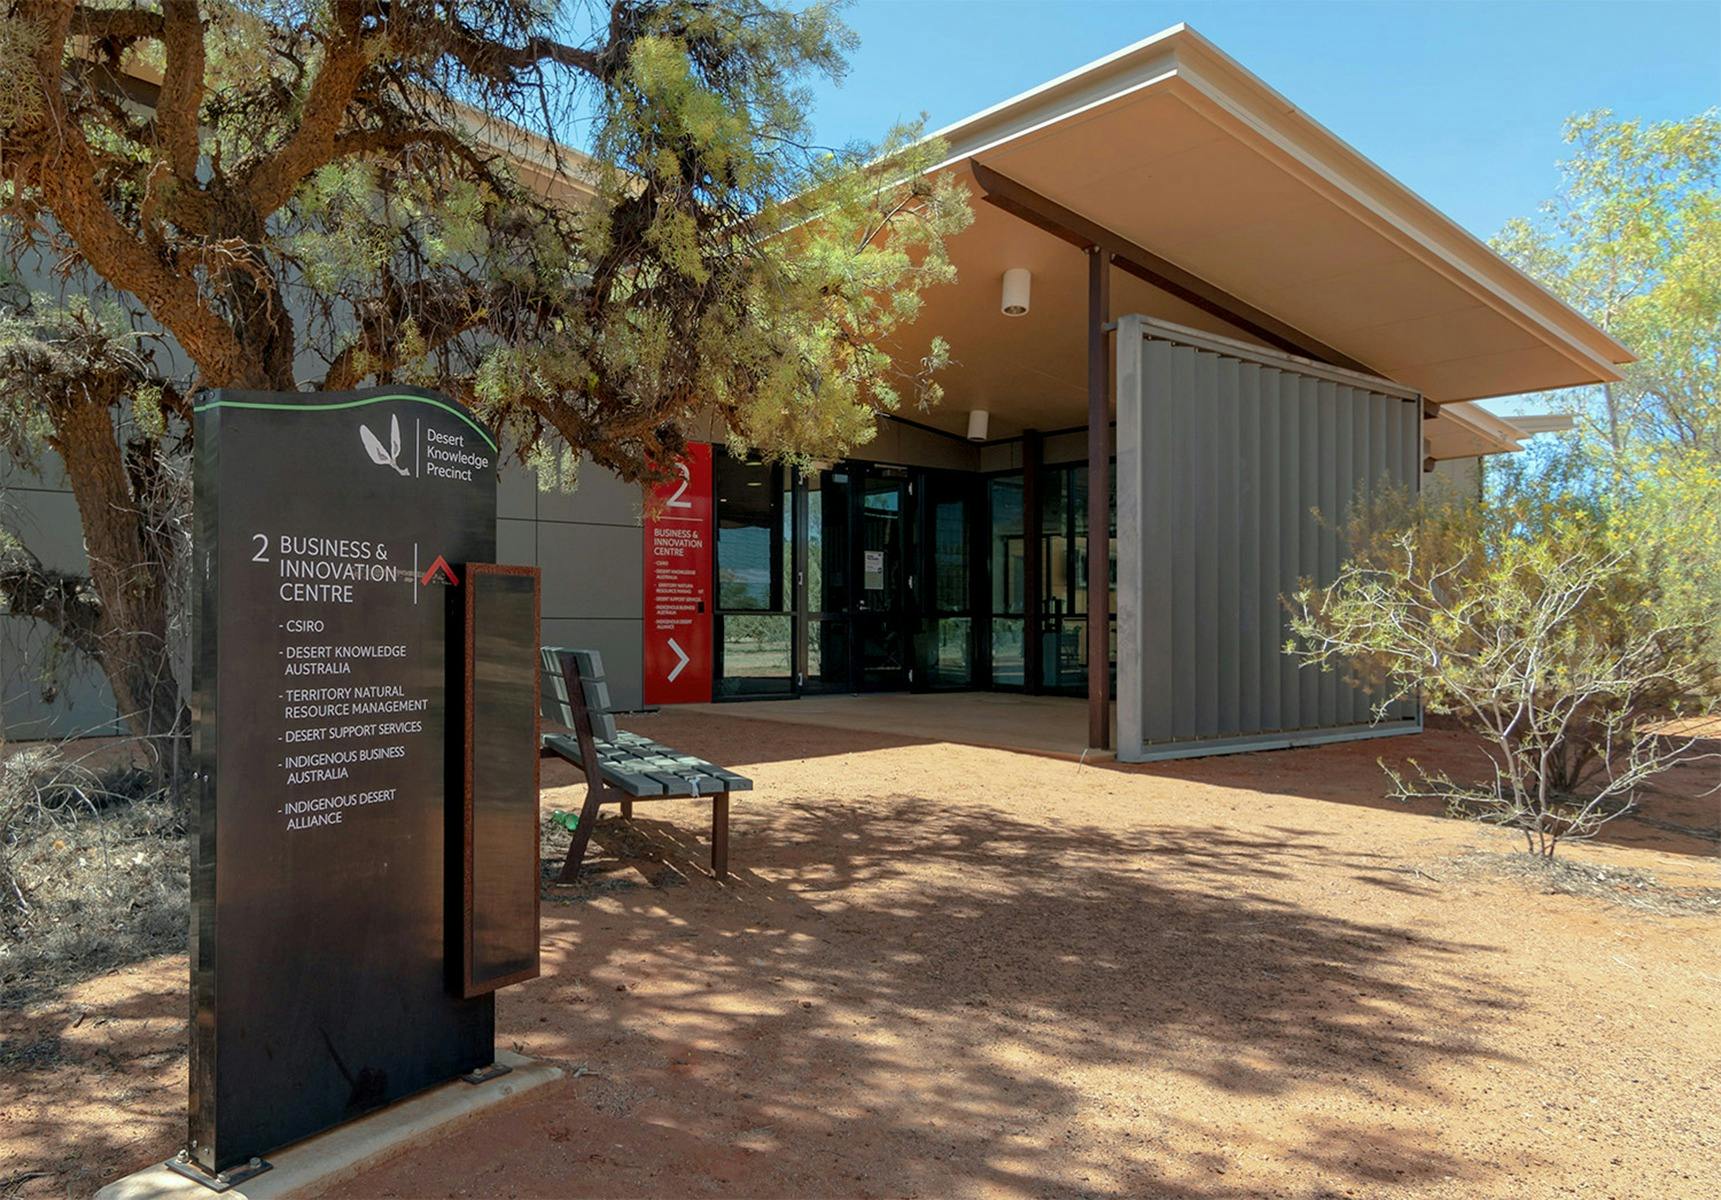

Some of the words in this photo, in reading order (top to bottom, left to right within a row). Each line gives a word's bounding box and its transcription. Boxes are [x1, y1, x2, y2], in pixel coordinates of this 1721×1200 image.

[427, 428, 464, 448] Desert
[427, 446, 489, 469] Knowledge
[426, 462, 472, 482] Precinct
[665, 462, 692, 508] 2
[654, 528, 691, 538] BUSINESS
[692, 530, 699, 539] &
[654, 537, 703, 548] INNOVATION
[251, 533, 270, 563] 2
[280, 535, 371, 560] BUSINESS
[375, 543, 388, 561] &
[653, 546, 684, 557] CENTRE
[280, 559, 397, 582] INNOVATION
[279, 583, 353, 603] CENTRE
[286, 620, 324, 632] CSIRO
[286, 646, 332, 658] DESERT
[335, 645, 406, 658] KNOWLEDGE
[285, 662, 351, 675] AUSTRALIA
[286, 688, 351, 702] TERRITORY
[354, 685, 405, 699] NATURAL
[285, 703, 350, 719] RESOURCE
[352, 699, 428, 715] MANAGEMENT
[285, 727, 327, 743] DESERT
[329, 724, 375, 739] SUPPORT
[378, 720, 422, 735] SERVICES
[285, 750, 358, 769] INDIGENOUS
[359, 745, 405, 762] BUSINESS
[287, 767, 349, 785] AUSTRALIA
[285, 794, 358, 815] INDIGENOUS
[359, 788, 396, 805] DESERT
[286, 811, 343, 831] ALLIANCE
